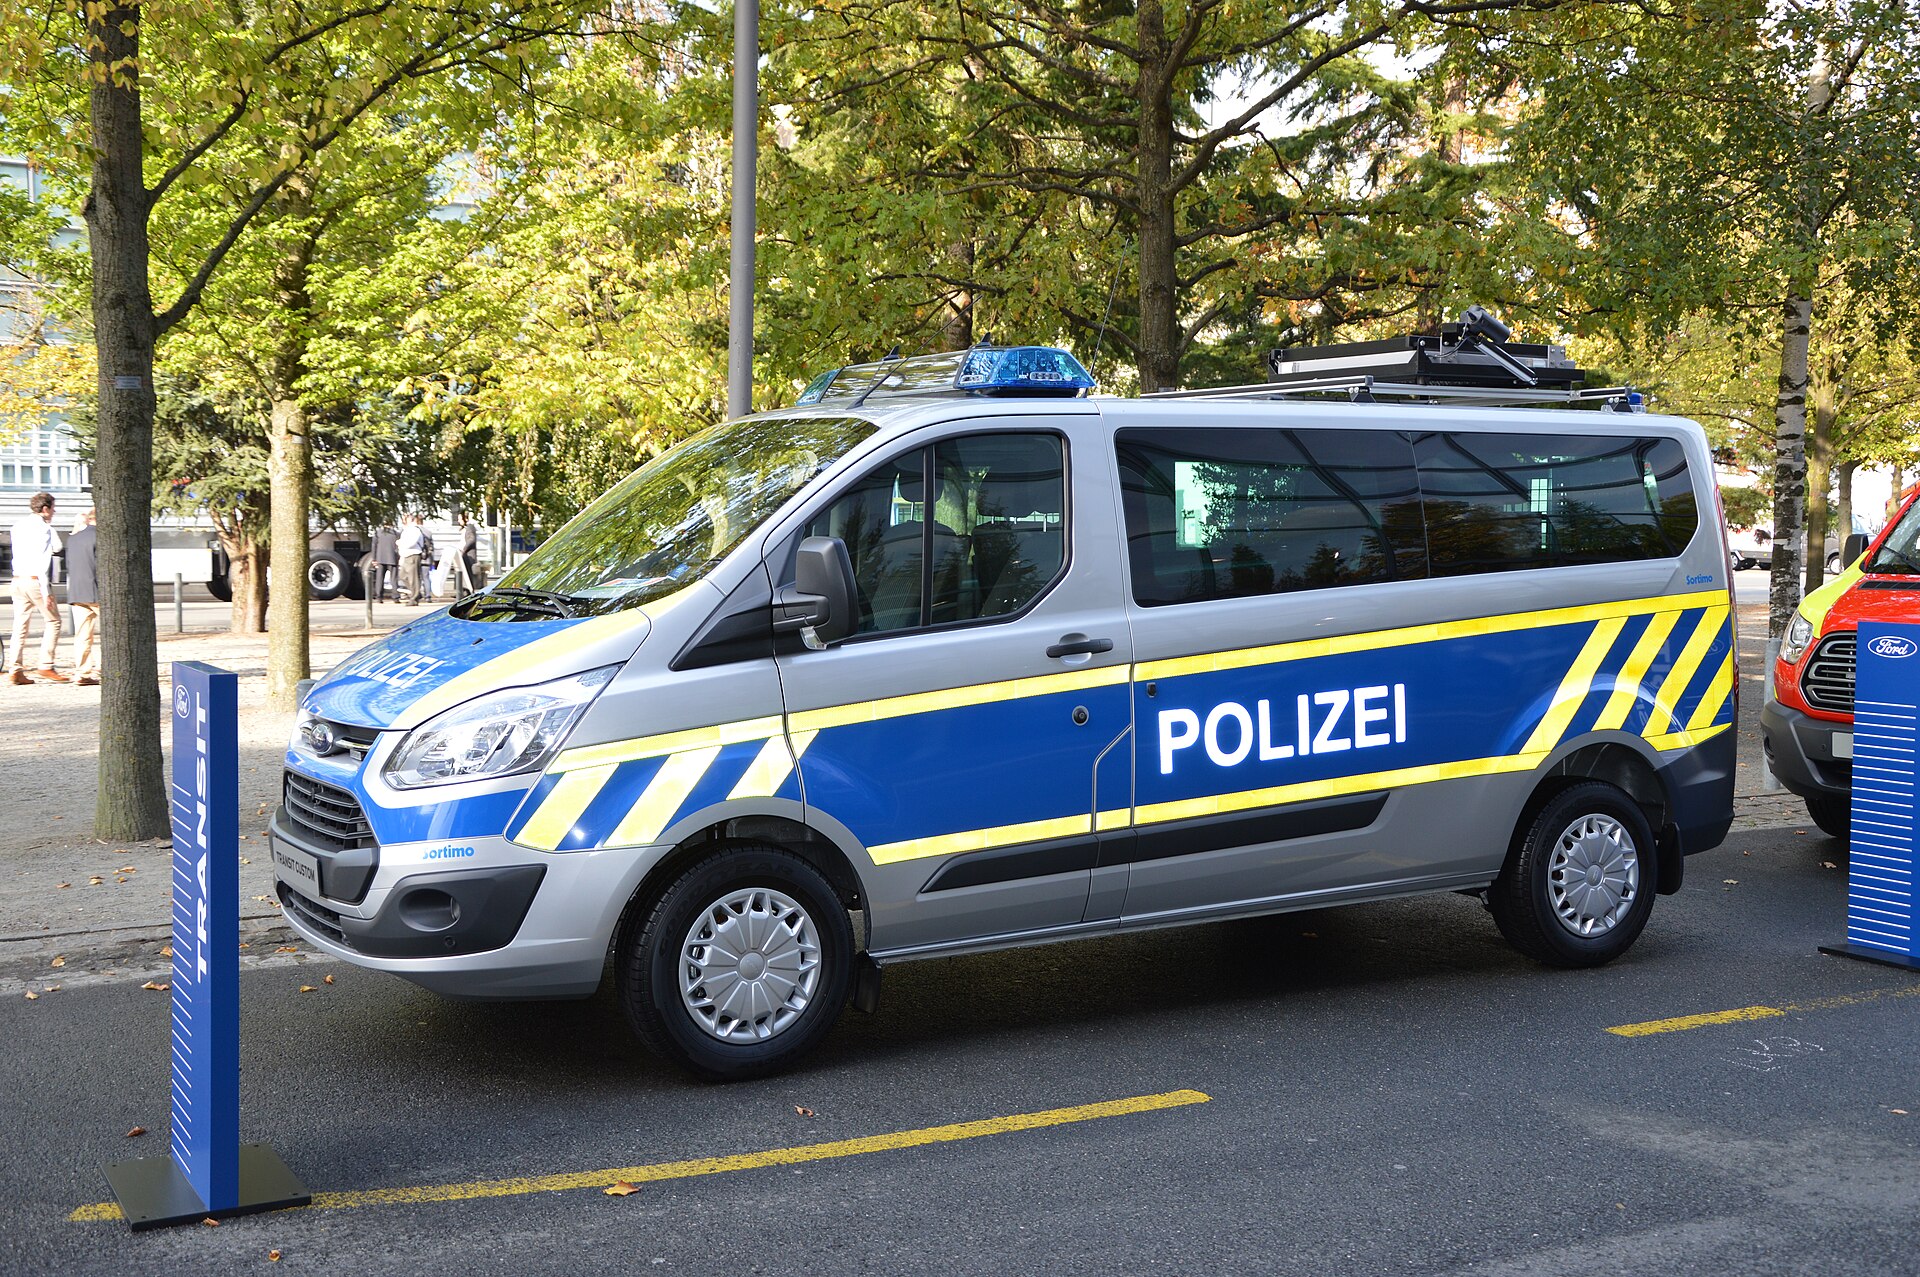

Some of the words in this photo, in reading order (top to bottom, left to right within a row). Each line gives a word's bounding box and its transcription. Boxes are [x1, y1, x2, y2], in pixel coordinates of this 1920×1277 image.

[1686, 573, 1713, 586] Sortimo
[1876, 638, 1909, 655] Ford
[335, 649, 447, 689] POLIZEI
[176, 688, 188, 714] Ford
[1158, 683, 1406, 775] POLIZEI
[196, 691, 208, 984] TRANSIT
[276, 851, 295, 871] TRANSIT
[295, 861, 315, 882] CUSTOM
